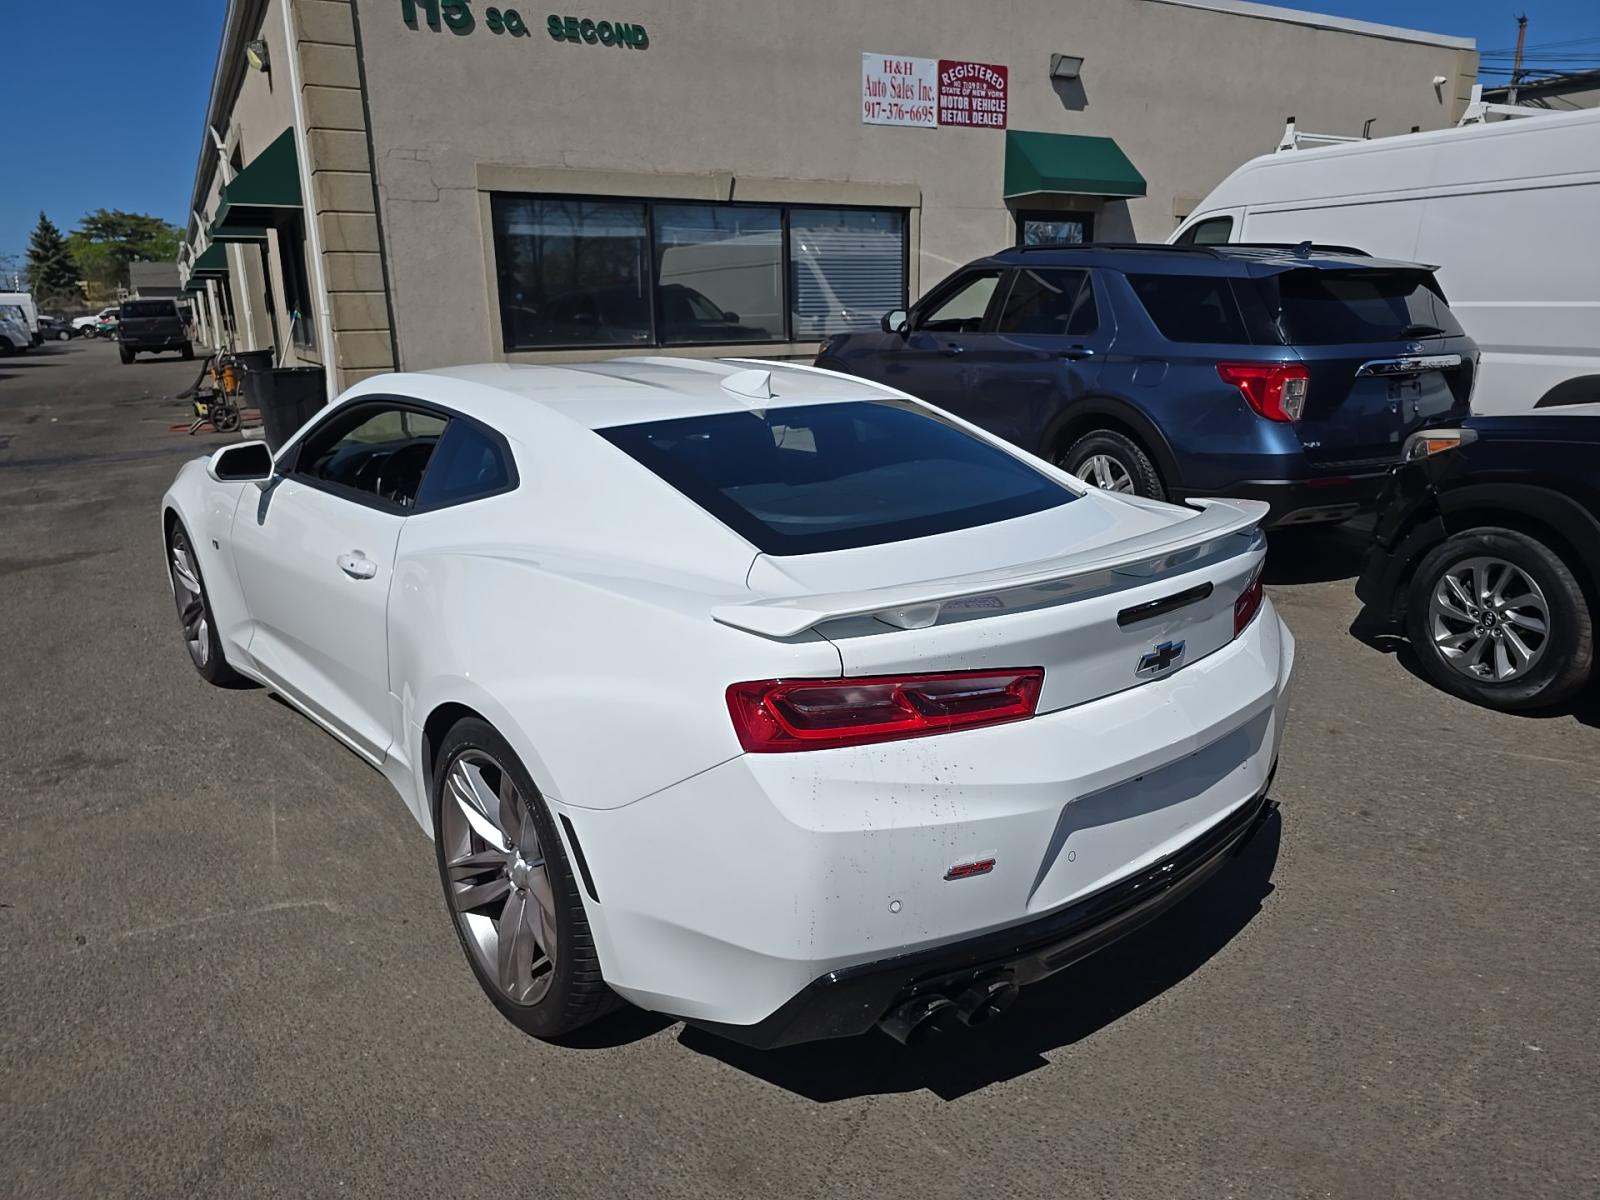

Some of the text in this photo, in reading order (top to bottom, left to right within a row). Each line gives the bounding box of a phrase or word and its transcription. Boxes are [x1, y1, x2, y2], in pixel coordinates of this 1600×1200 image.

[547, 14, 649, 49] SECOND
[883, 60, 913, 75] H&H
[941, 64, 1004, 89] REGISTERED
[865, 75, 935, 101] Auto Sales Inc.
[988, 90, 1004, 98] YORK
[864, 102, 934, 122] 917-376-6695
[940, 95, 1006, 112] MOTOR VEHICLE
[941, 110, 1004, 125] RETAIL DEALER
